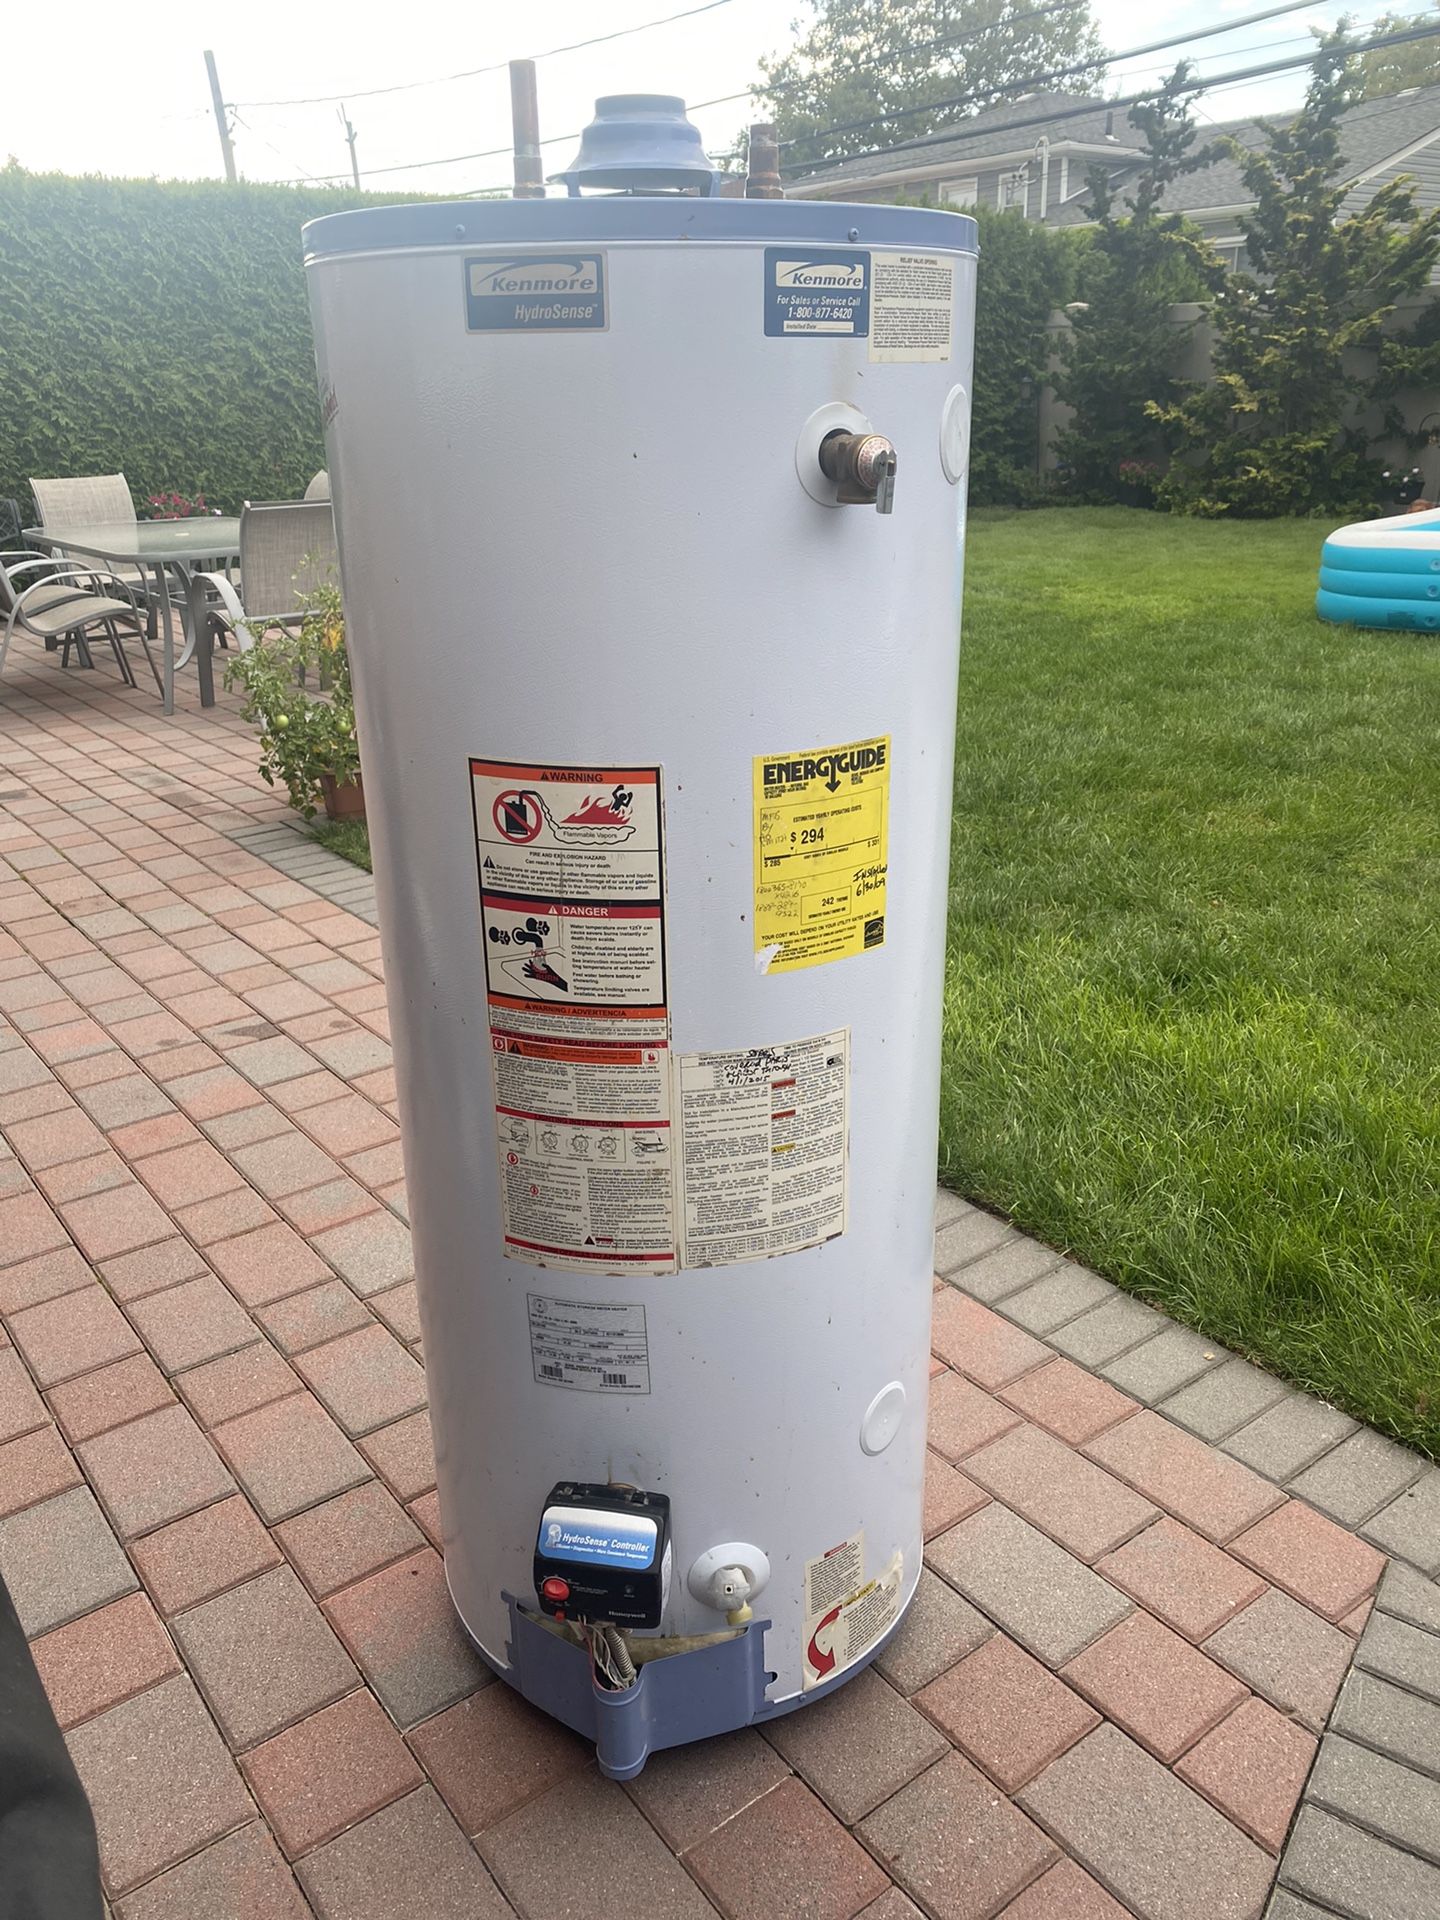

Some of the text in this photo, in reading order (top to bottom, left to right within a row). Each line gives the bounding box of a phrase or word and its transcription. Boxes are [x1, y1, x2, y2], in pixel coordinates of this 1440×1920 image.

[492, 277, 594, 292] Kenmore
[792, 272, 862, 288] Kenmore
[777, 294, 861, 306] For Sales or Service Call
[788, 307, 853, 319] 1-800-877-6420
[764, 744, 886, 785] ENERGYGUIDE
[550, 772, 603, 783] WARNING
[790, 832, 796, 843] $
[801, 828, 824, 844] 294
[821, 897, 834, 907] 242
[562, 906, 609, 917] DANGER
[800, 927, 817, 935] DEPEND
[533, 1003, 566, 1013] WARNING
[571, 1008, 627, 1016] ADVERTENCIA
[611, 1540, 649, 1552] Controller
